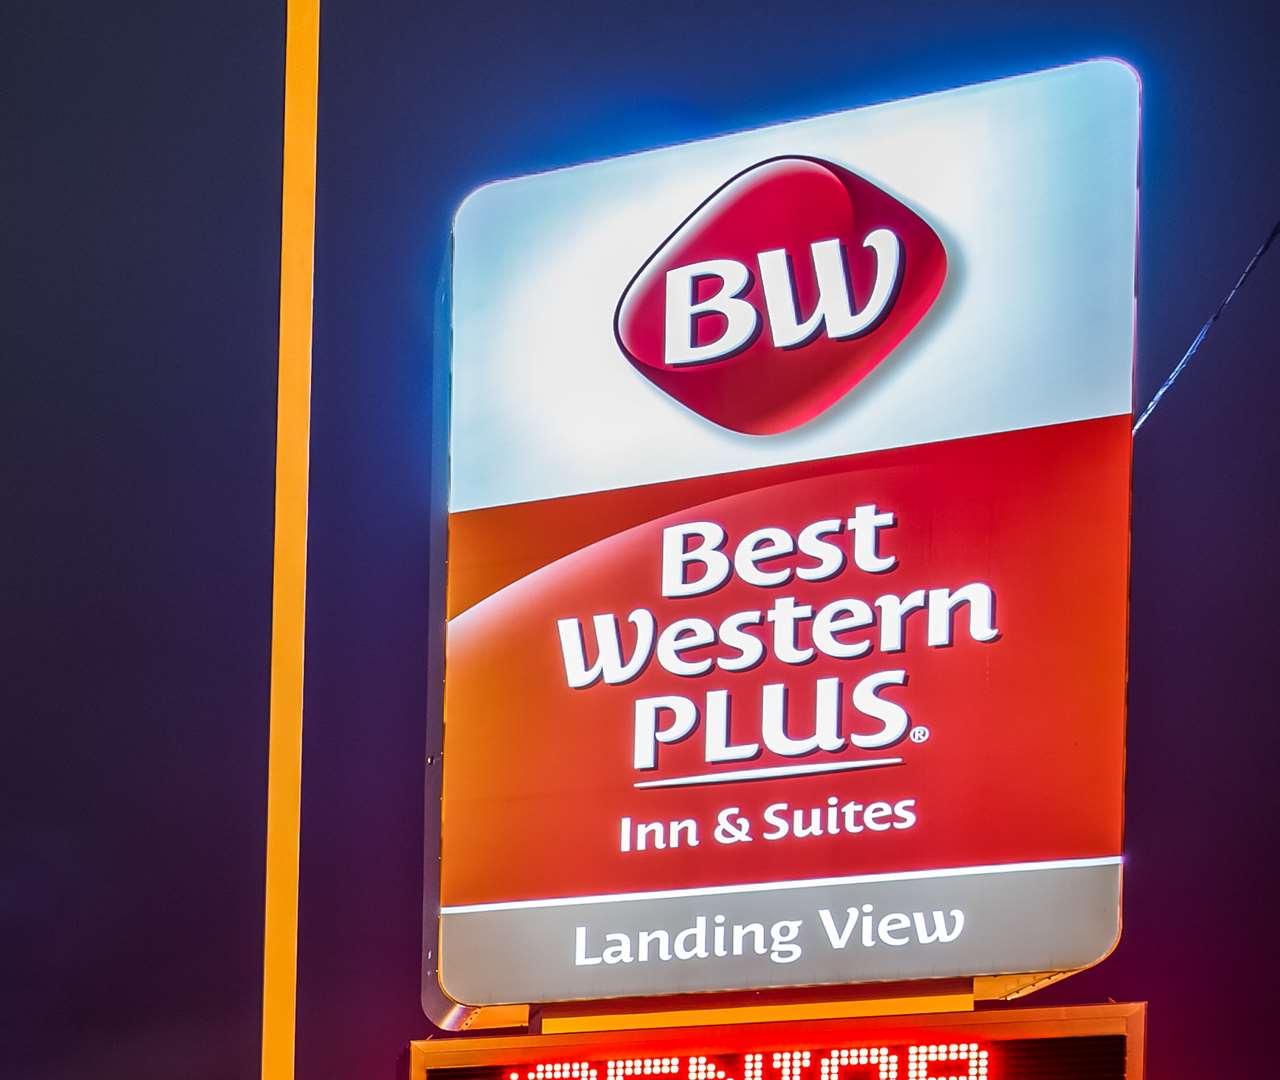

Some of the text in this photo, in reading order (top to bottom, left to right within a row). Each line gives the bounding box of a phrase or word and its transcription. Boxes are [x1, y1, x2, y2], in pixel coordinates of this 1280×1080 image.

[664, 228, 903, 366] BW
[661, 504, 898, 598] Best
[556, 582, 1002, 689] Western
[619, 796, 917, 853] Inn & Suites
[574, 904, 966, 967] Landing View
